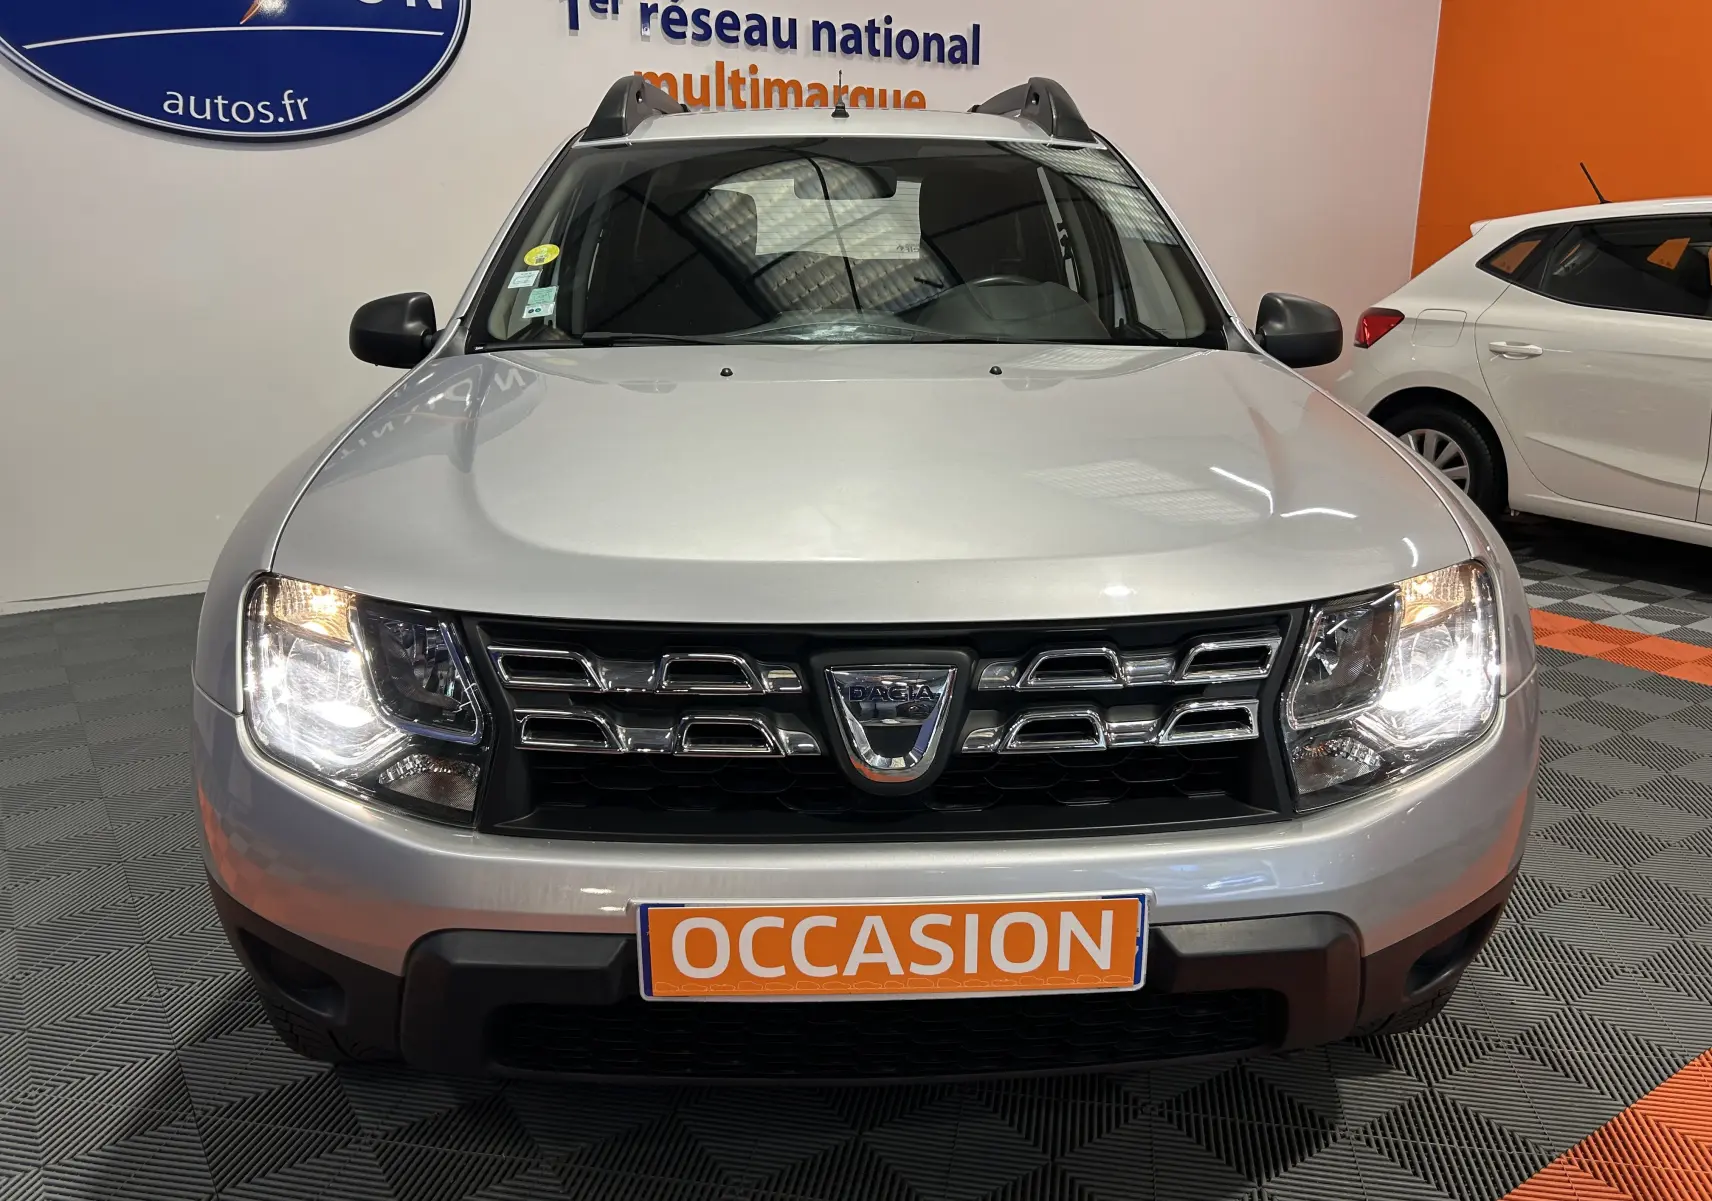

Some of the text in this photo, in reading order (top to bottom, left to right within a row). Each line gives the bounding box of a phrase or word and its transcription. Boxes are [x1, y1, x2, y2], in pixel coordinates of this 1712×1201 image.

[640, 0, 797, 49] réseau
[812, 15, 980, 65] national
[163, 89, 309, 124] autos.fr
[672, 911, 1114, 978] OCCASION
